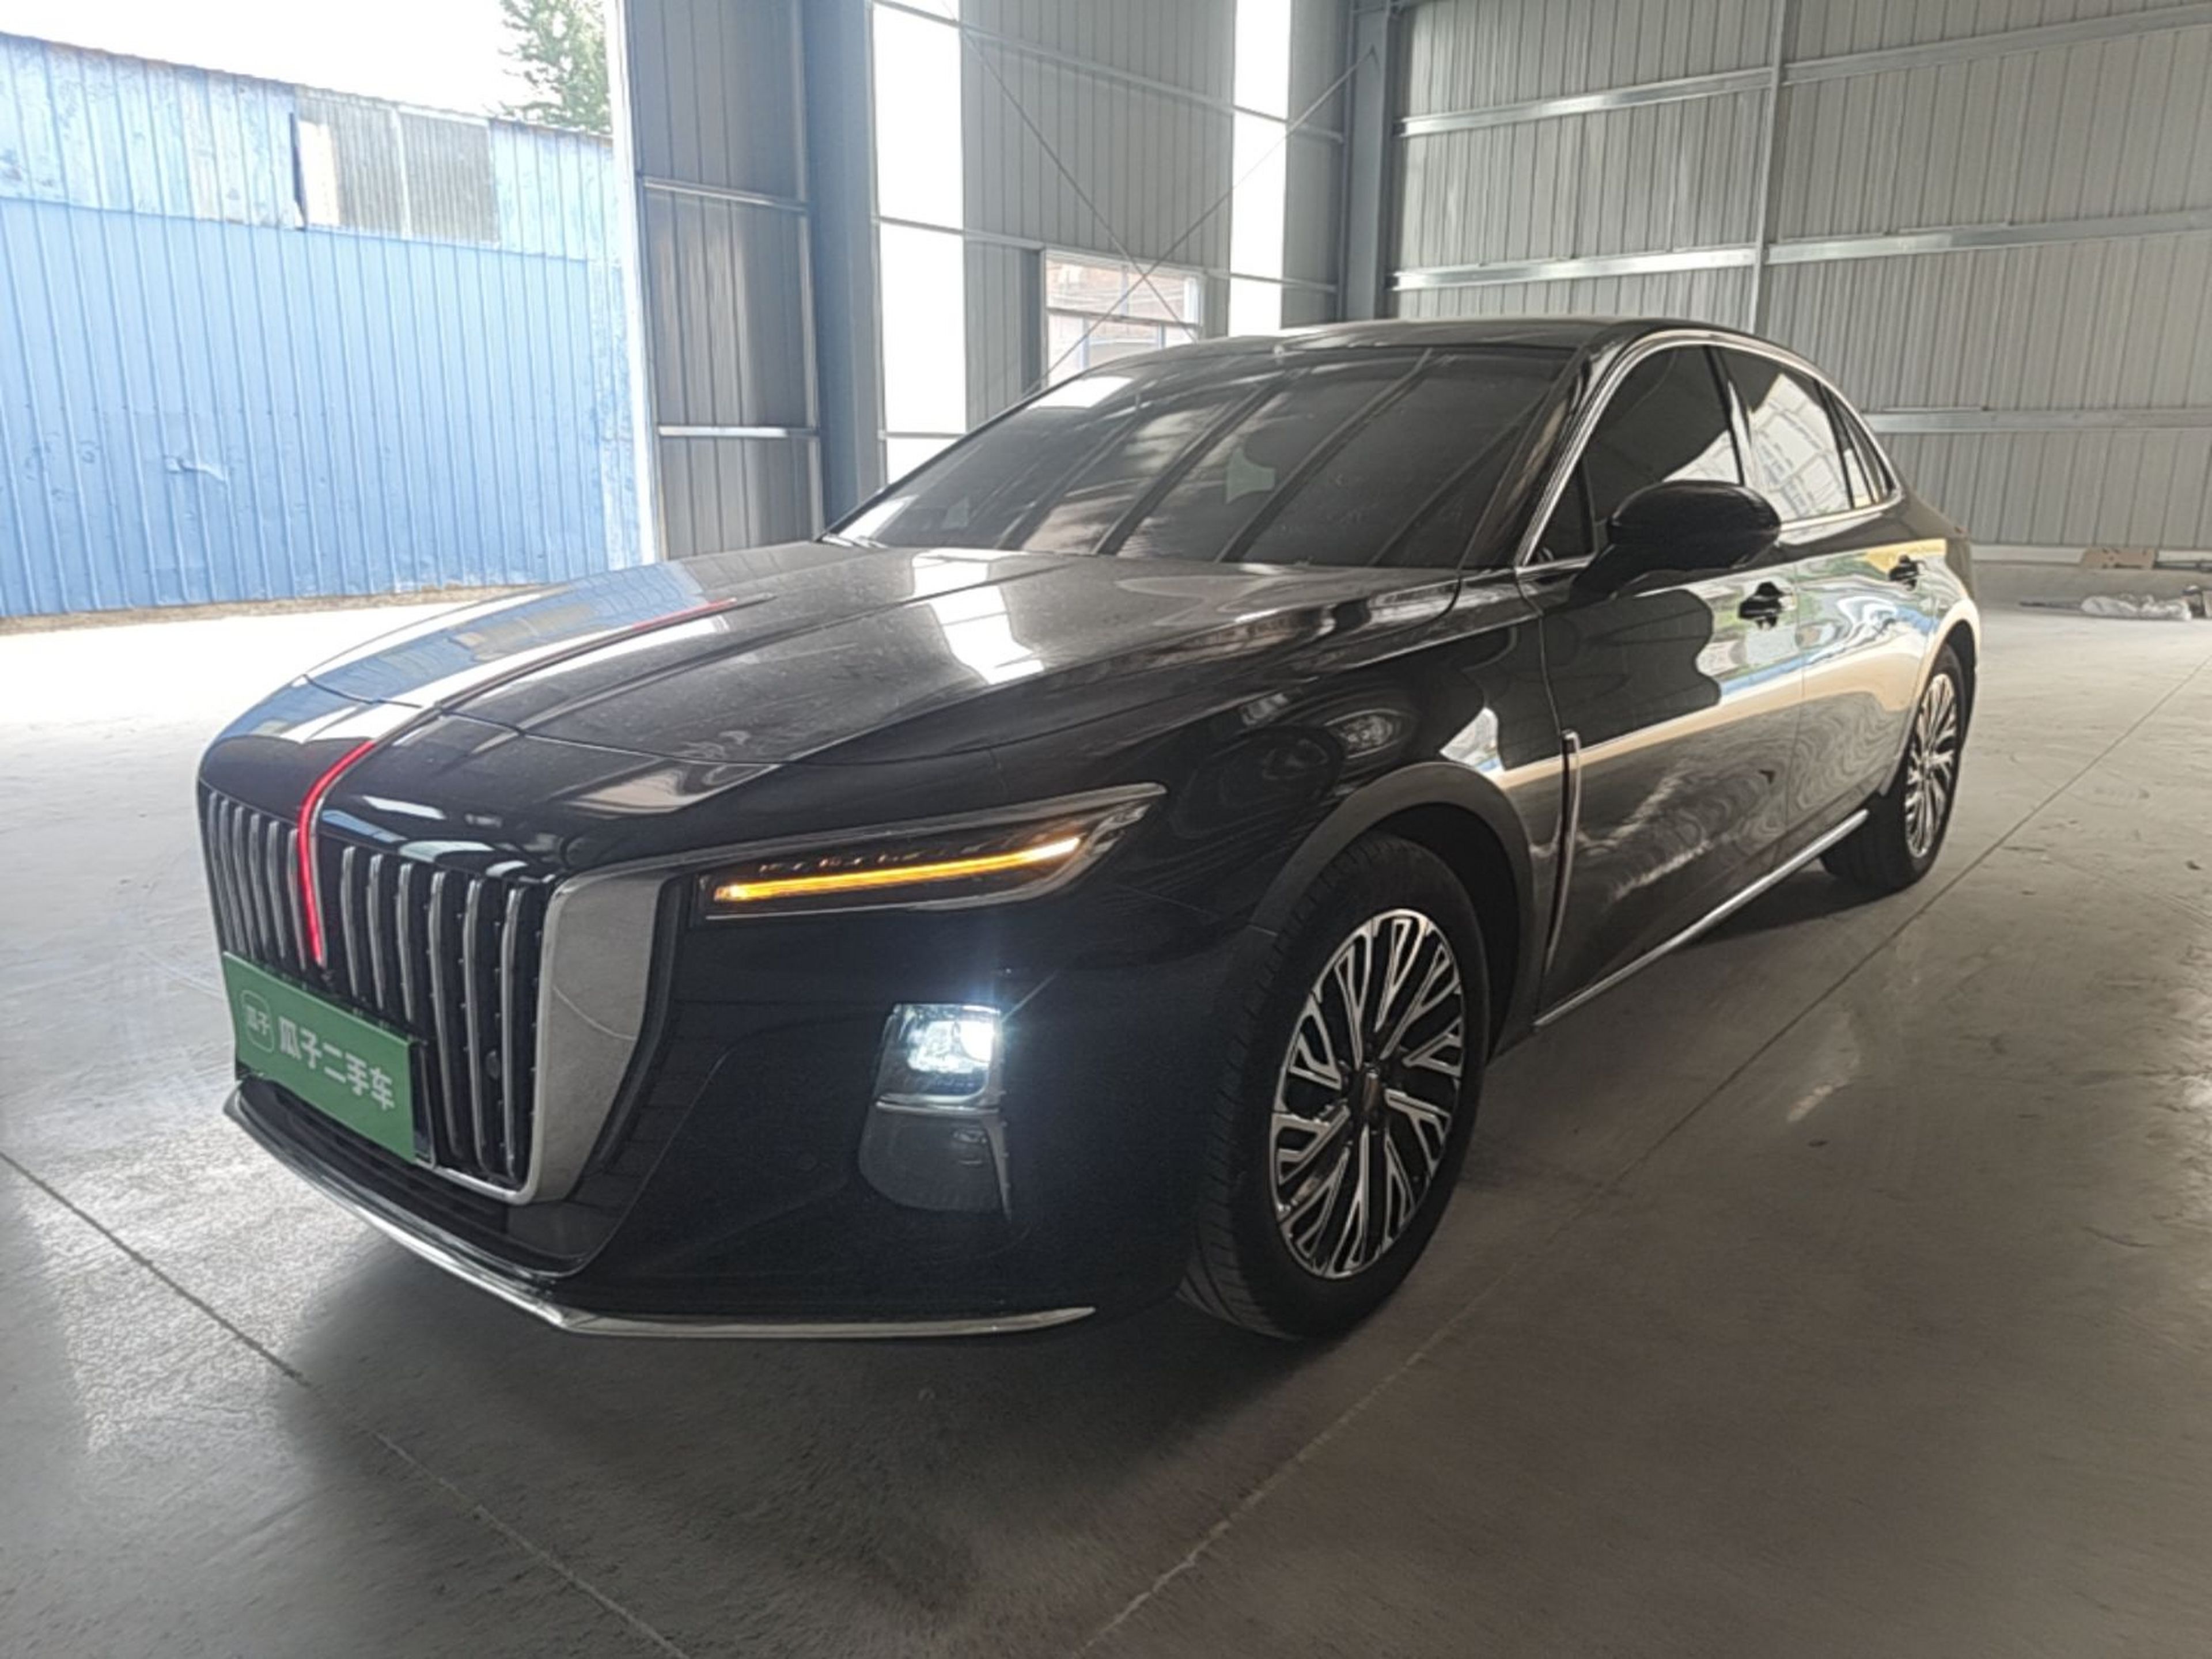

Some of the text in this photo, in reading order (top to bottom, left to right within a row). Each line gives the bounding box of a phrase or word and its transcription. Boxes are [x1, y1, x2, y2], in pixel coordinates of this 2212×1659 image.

[278, 1016, 395, 1111] 瓜子二手车
